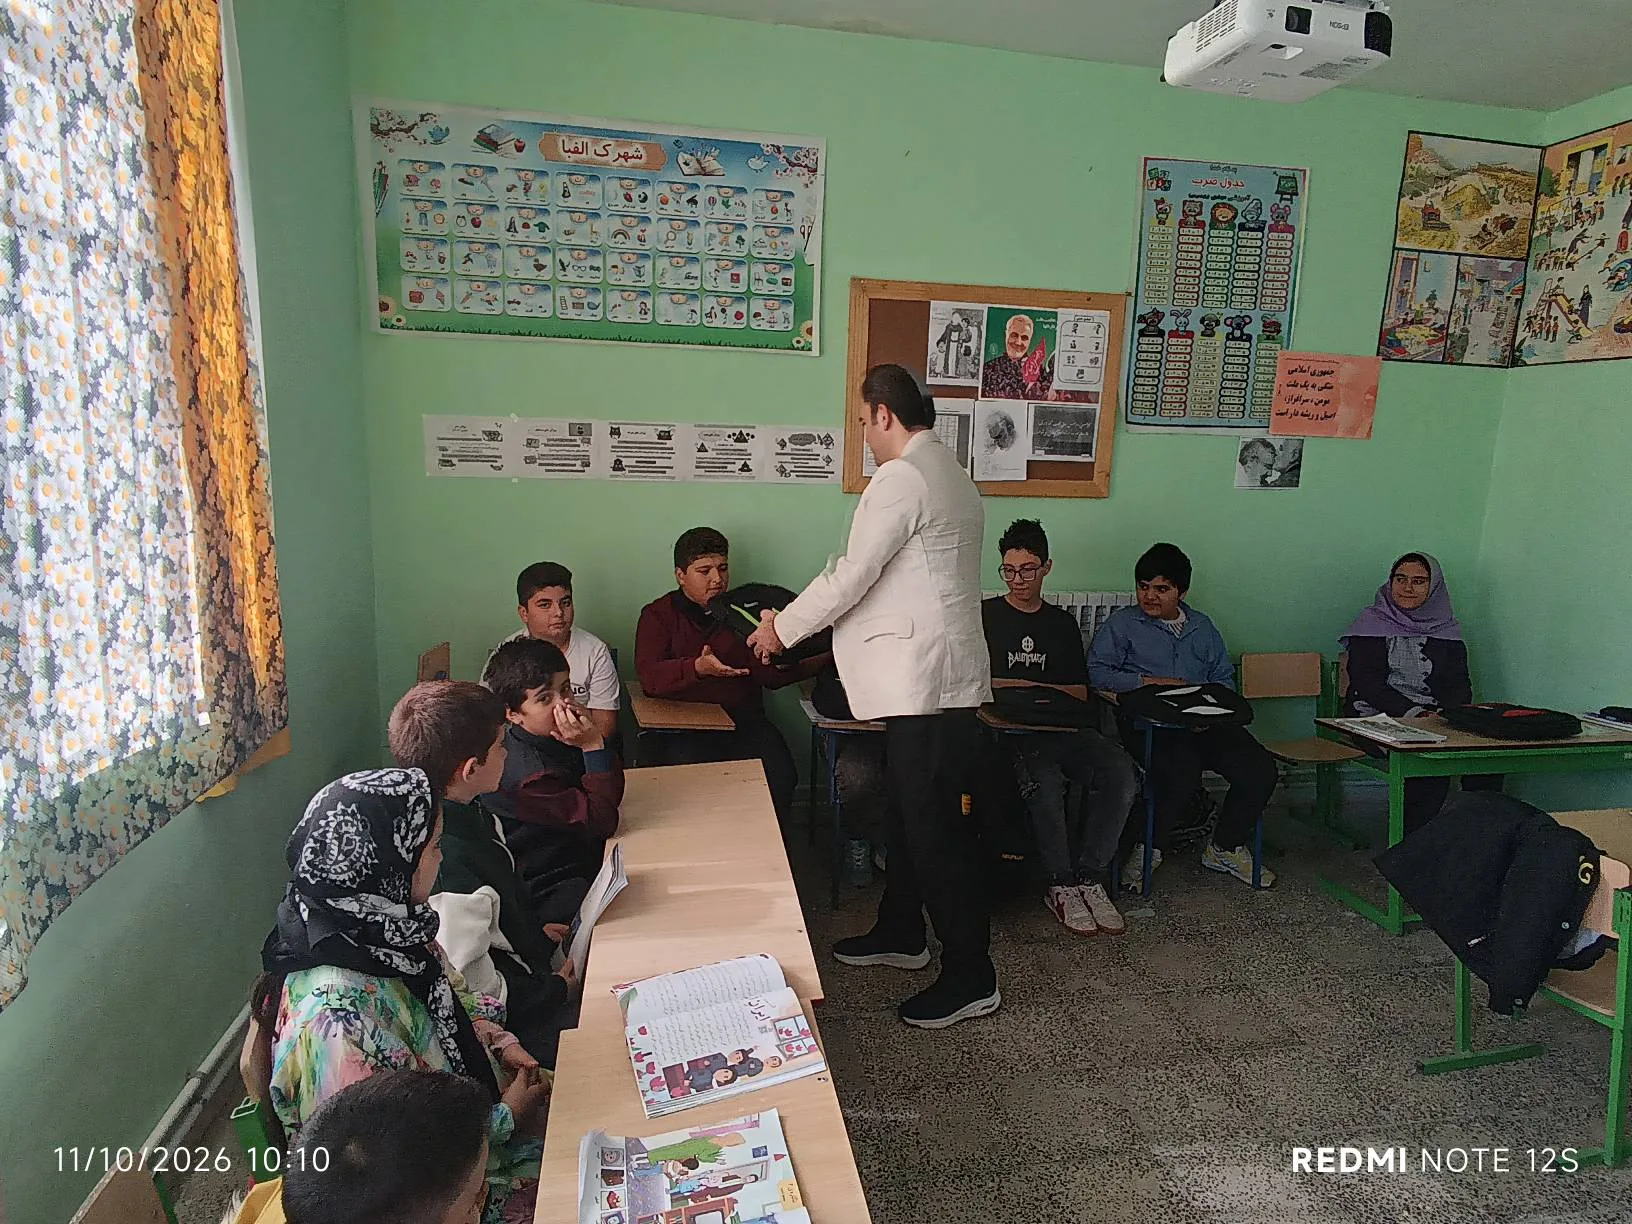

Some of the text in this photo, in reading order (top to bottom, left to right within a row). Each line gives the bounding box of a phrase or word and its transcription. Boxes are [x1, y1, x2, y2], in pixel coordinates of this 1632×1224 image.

[561, 139, 643, 162] شهرک الفبا
[1287, 364, 1310, 375] اسلامی
[1286, 379, 1300, 388] ملت
